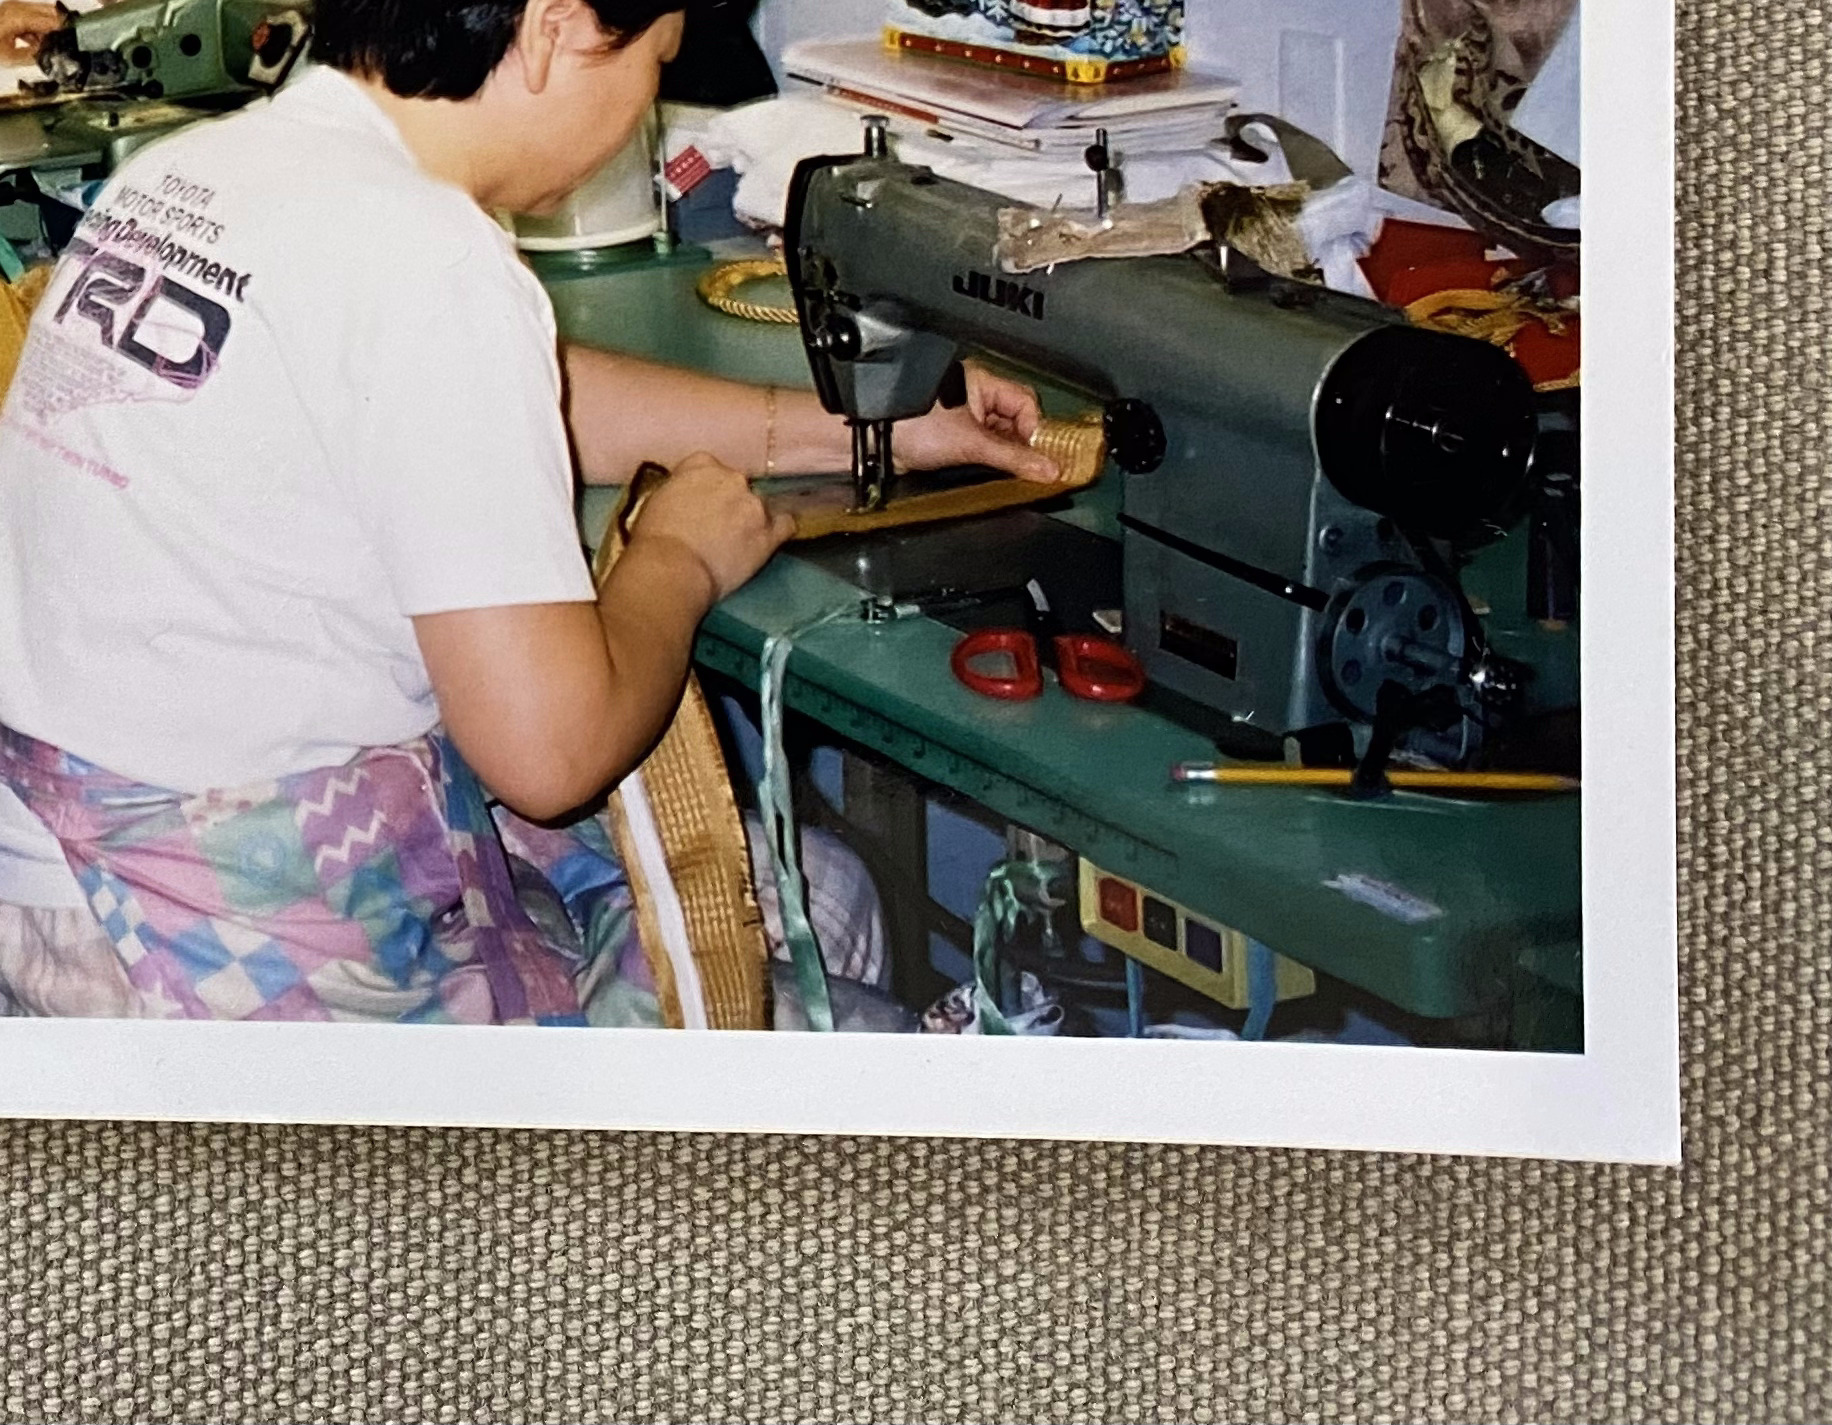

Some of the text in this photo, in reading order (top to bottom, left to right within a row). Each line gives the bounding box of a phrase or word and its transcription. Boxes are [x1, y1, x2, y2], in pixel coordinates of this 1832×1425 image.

[114, 186, 226, 245] MOTOR SPORTS
[159, 174, 216, 209] TOYOTA
[54, 237, 232, 389] TRD
[952, 270, 1045, 321] JUKI
